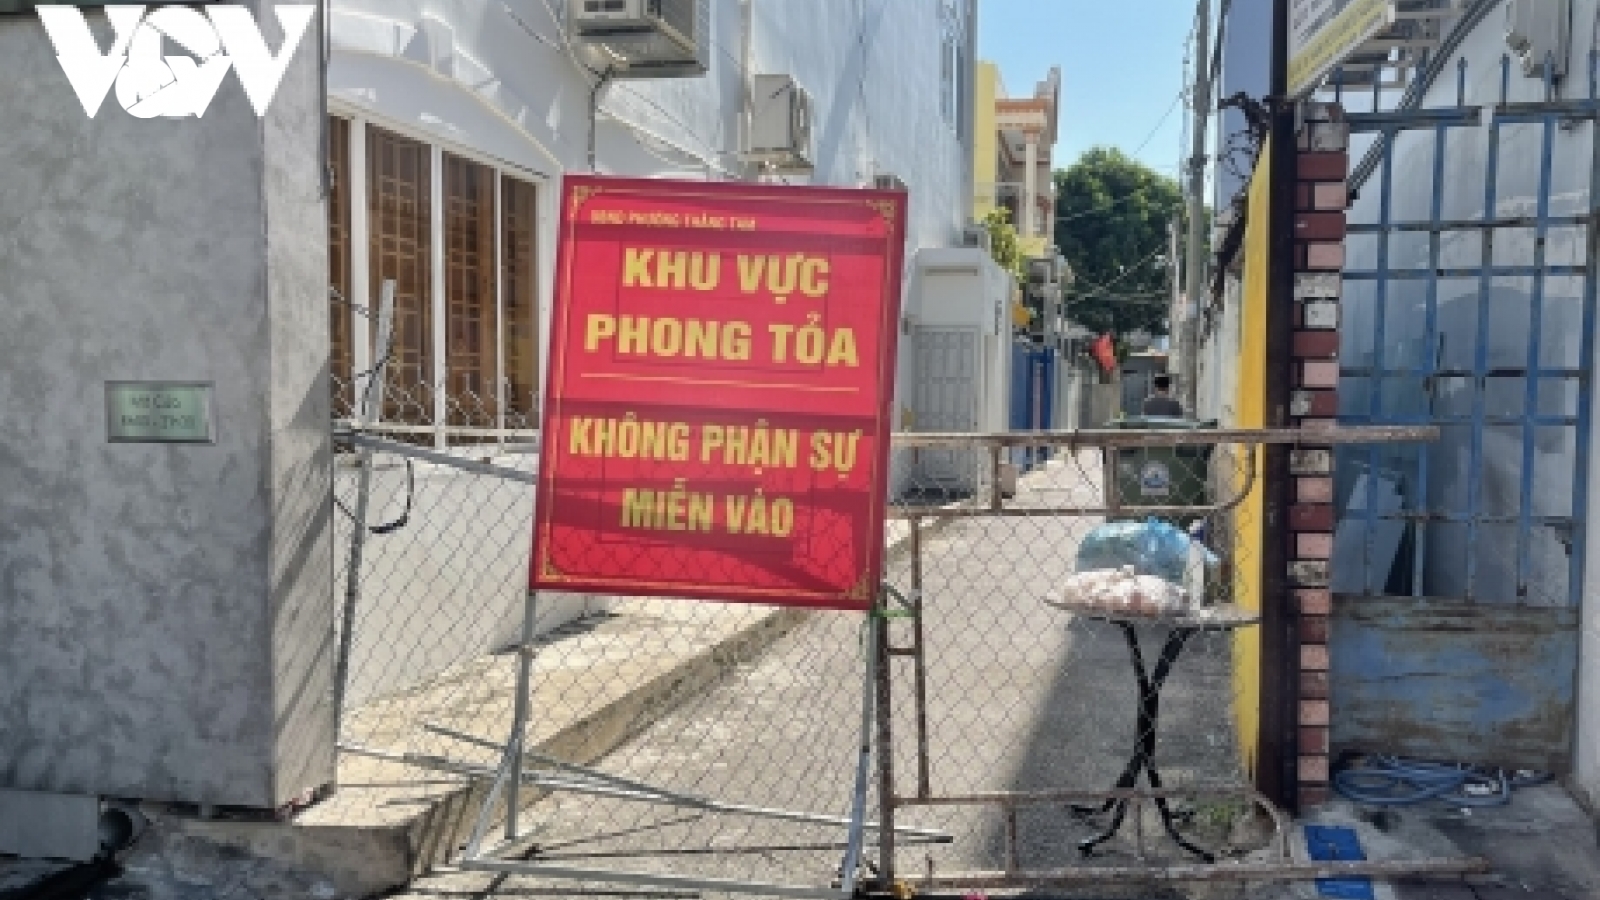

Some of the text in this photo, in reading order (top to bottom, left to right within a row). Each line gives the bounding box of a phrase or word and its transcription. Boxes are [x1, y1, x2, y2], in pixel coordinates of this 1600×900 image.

[622, 247, 831, 304] KHU VỰC
[585, 311, 860, 367] PHONG TỎA
[570, 411, 863, 481] KHÔNG PHẬN SỰ
[727, 487, 794, 538] VÀO
